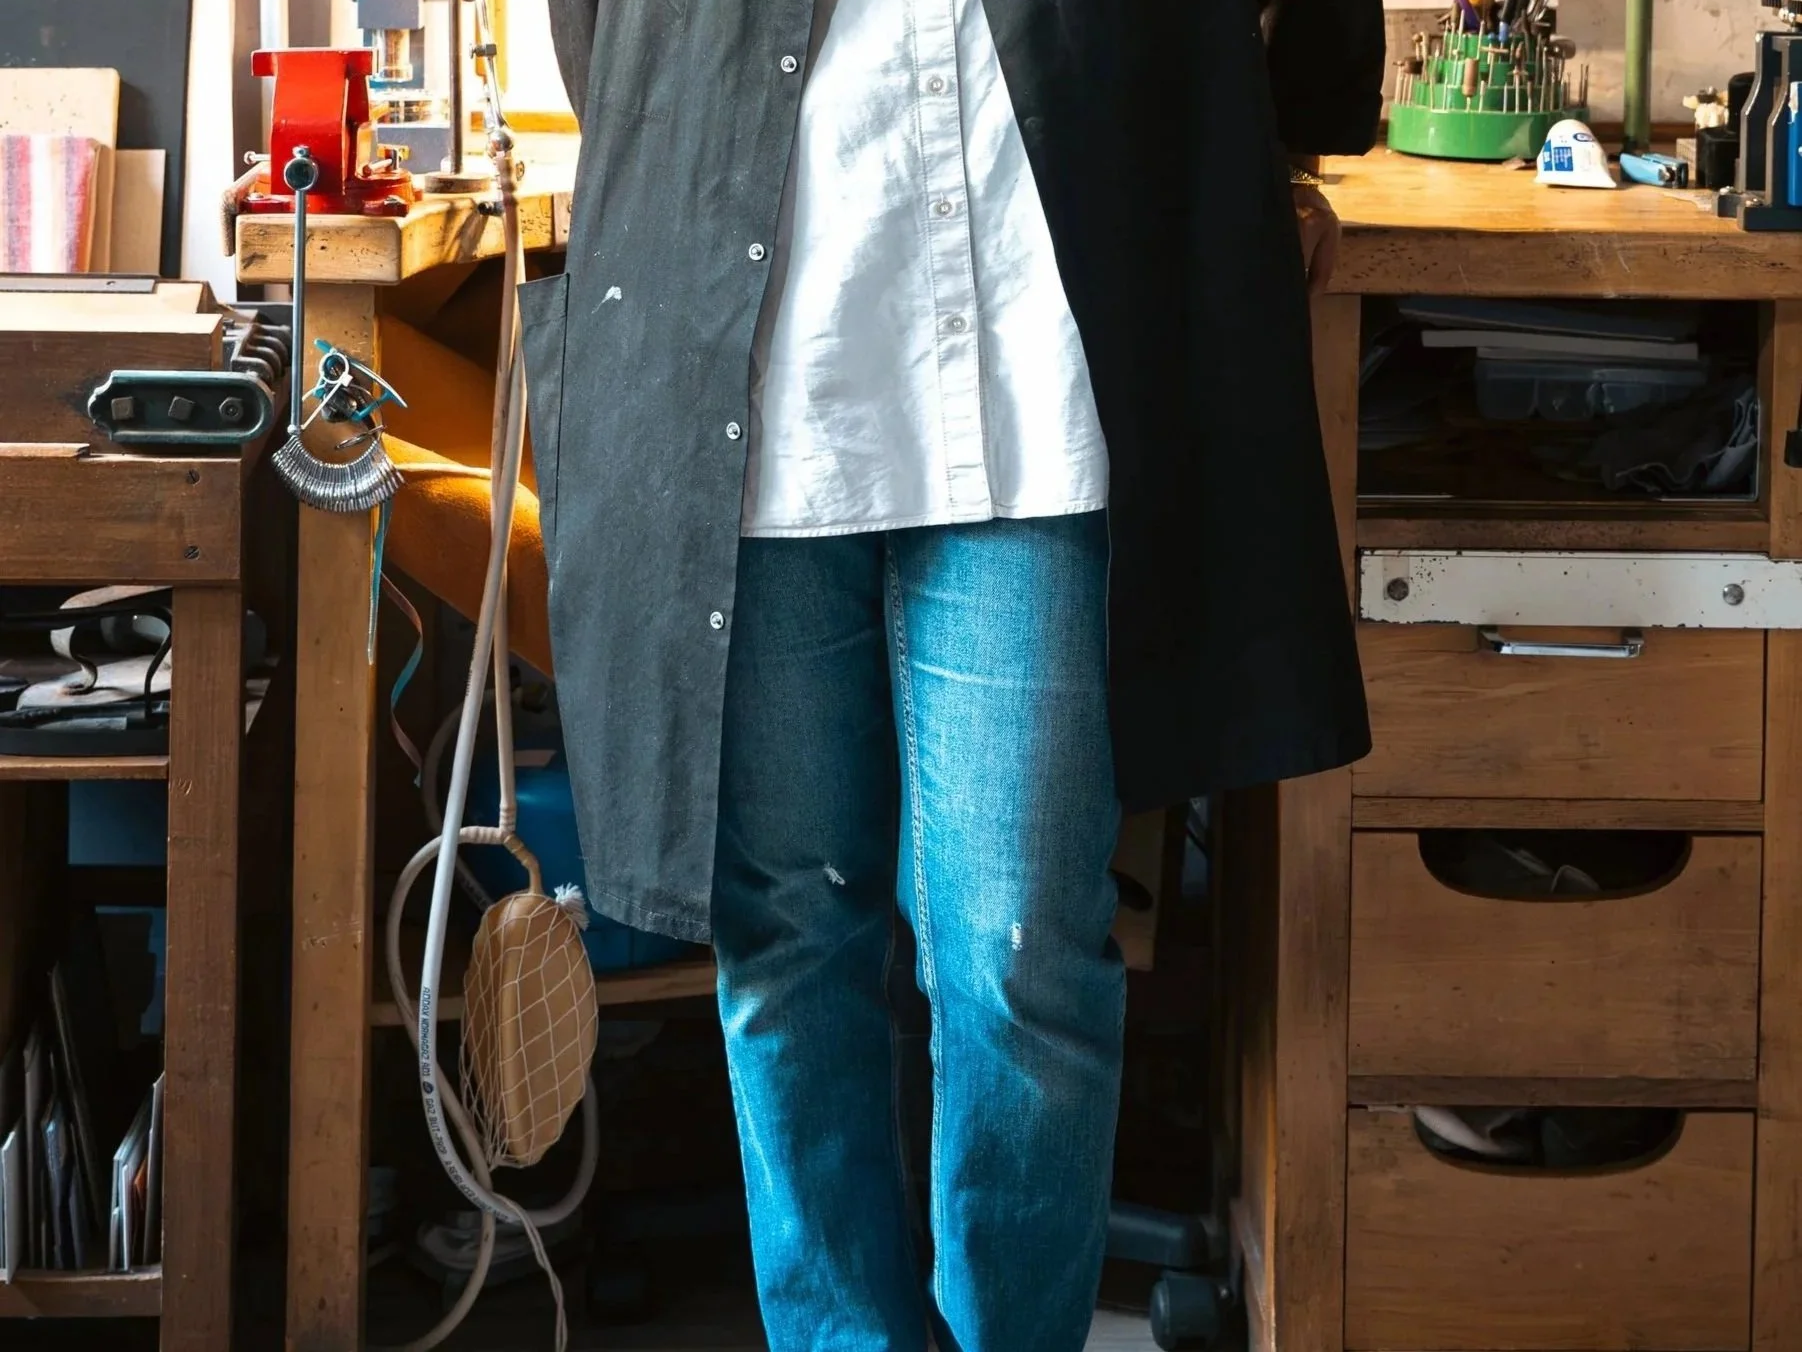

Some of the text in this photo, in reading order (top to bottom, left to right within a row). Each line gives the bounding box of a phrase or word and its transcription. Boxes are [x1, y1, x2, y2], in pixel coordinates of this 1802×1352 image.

[422, 987, 431, 1017] ADDAX
[421, 1018, 430, 1060] NORMAGAZ
[425, 1098, 436, 1114] GAZ
